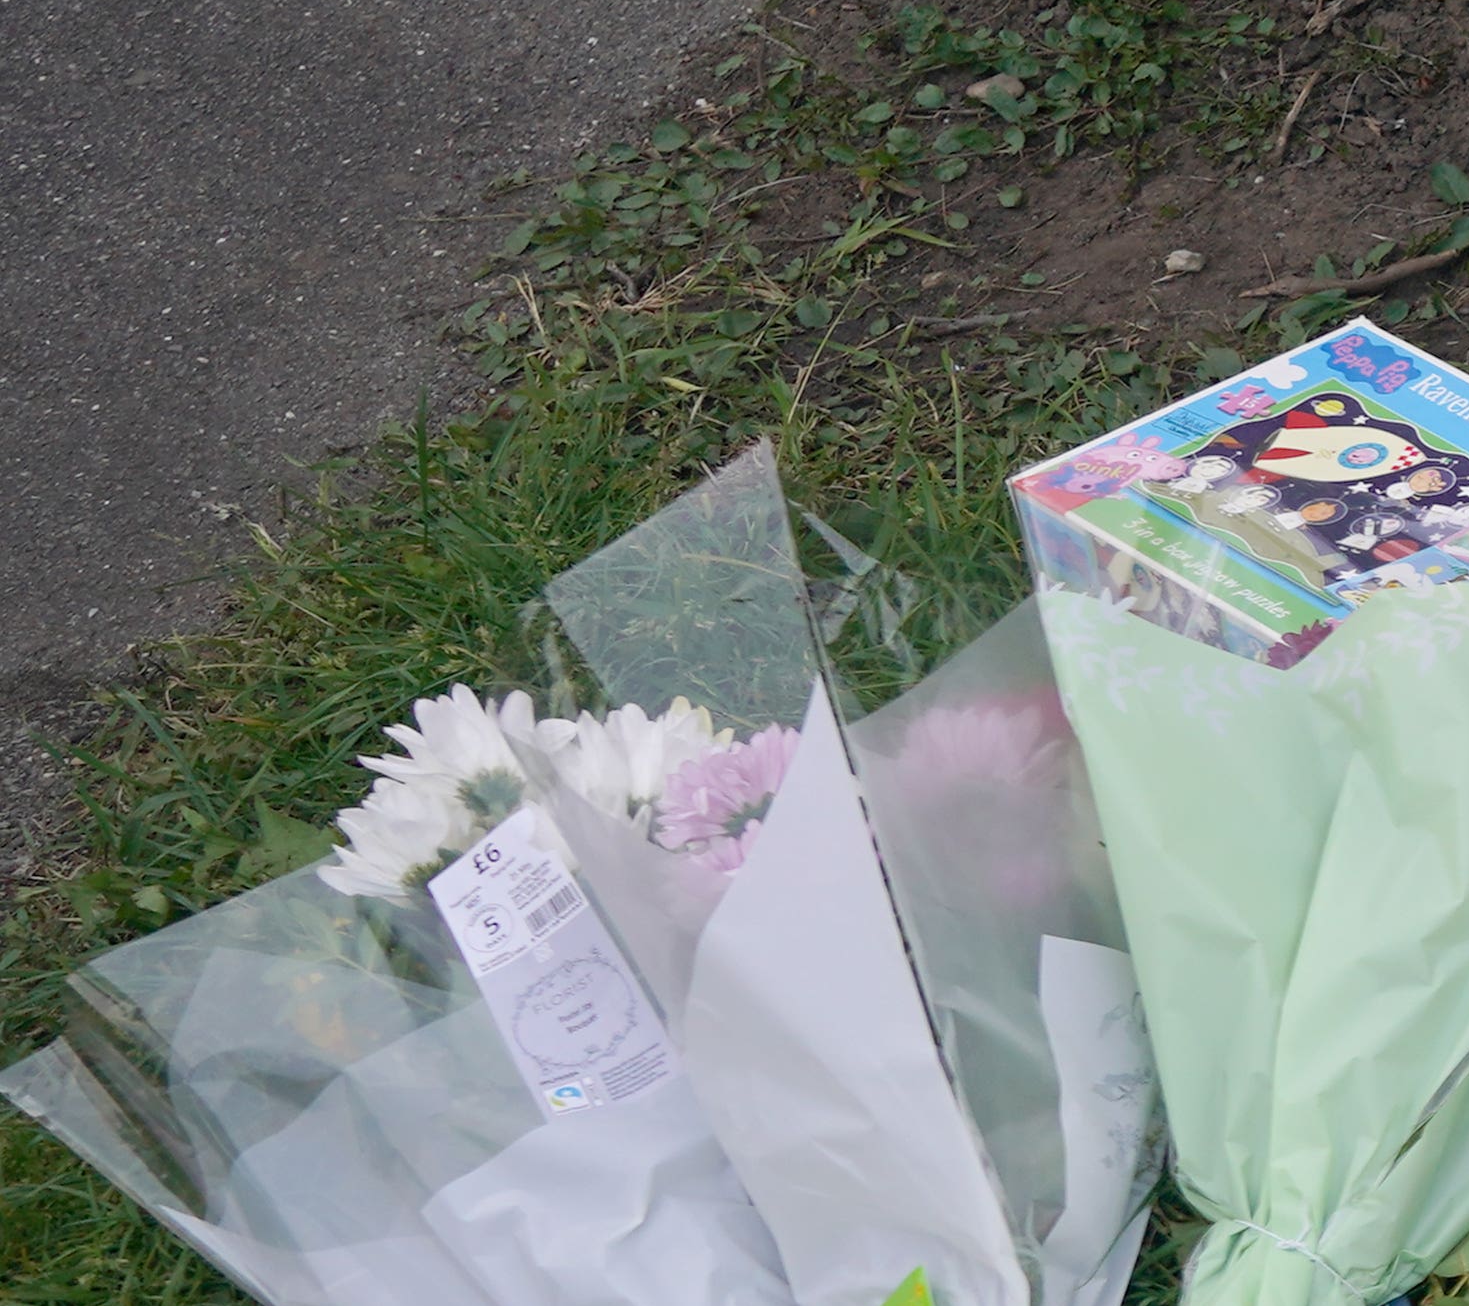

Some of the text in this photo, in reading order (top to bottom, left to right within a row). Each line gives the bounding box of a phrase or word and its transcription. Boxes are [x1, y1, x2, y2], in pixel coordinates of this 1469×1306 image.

[1330, 334, 1410, 394] Peppa Pig
[1238, 396, 1261, 410] 15
[1074, 461, 1137, 479] oink!
[1122, 517, 1144, 529] 3
[1134, 522, 1152, 540] in
[1150, 535, 1165, 547] a
[1161, 540, 1190, 564] box
[1234, 588, 1292, 620] puzzles
[473, 842, 501, 876] £6
[483, 915, 500, 936] 5
